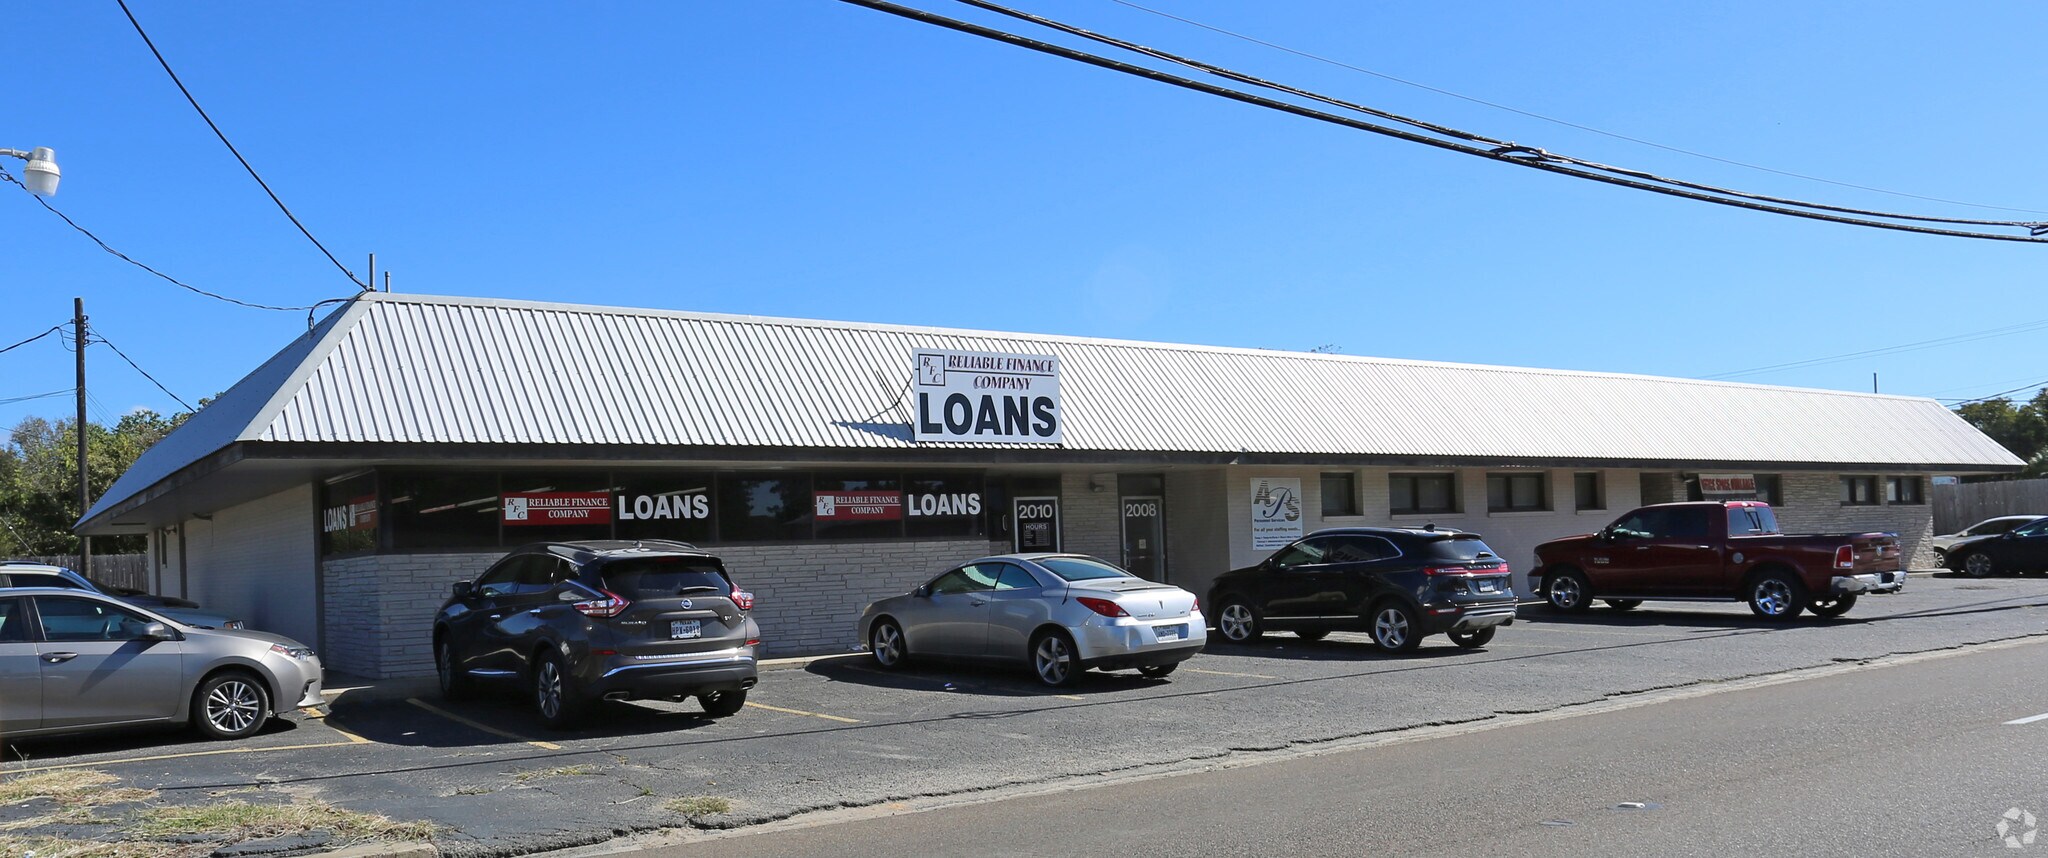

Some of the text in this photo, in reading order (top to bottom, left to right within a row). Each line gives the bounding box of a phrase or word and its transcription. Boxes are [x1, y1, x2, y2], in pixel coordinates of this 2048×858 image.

[948, 354, 1055, 373] RELIABLE FINANCE
[973, 375, 1033, 390] COMPANY
[919, 392, 1057, 438] LOANS
[528, 497, 608, 507] RELIABLE FINANCE
[618, 494, 709, 520] LOANS
[835, 496, 900, 504] RELIABLE FINANCE
[907, 493, 982, 516] LOANS
[548, 509, 590, 518] COMPANY
[851, 506, 885, 514] COMPANY
[1018, 503, 1053, 519] 2010
[1125, 503, 1157, 517] 2008
[324, 505, 347, 532] LOANS
